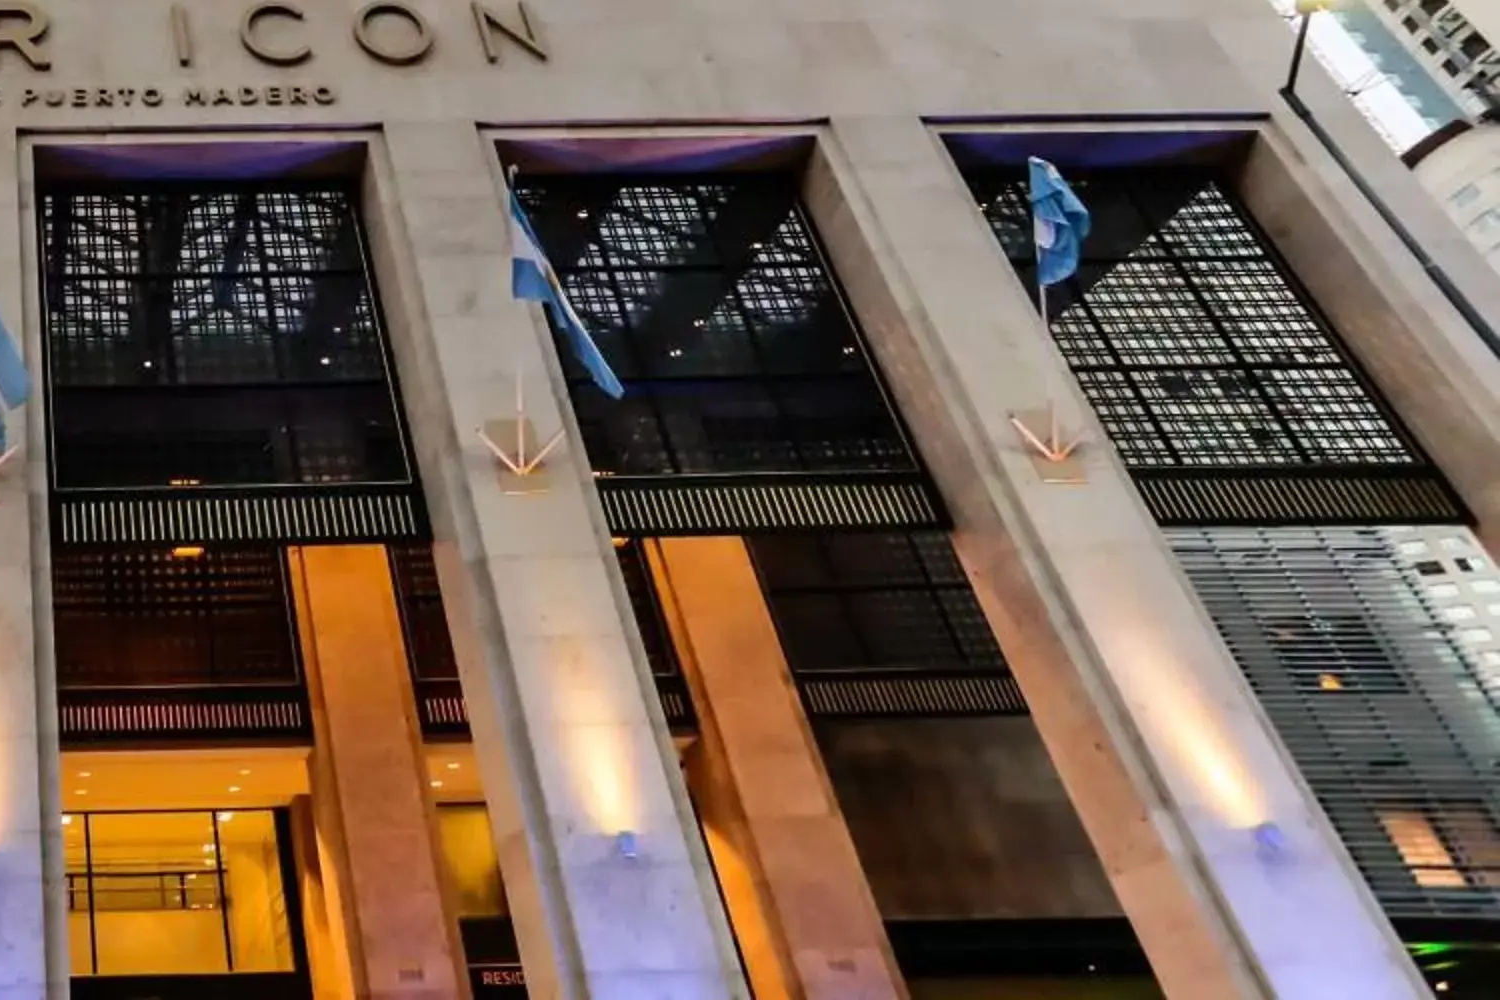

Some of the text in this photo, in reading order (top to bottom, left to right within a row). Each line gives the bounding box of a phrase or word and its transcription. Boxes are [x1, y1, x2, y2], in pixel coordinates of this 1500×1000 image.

[171, 0, 550, 70] ICON
[21, 88, 164, 107] PUERTO
[184, 86, 338, 106] MADERO
